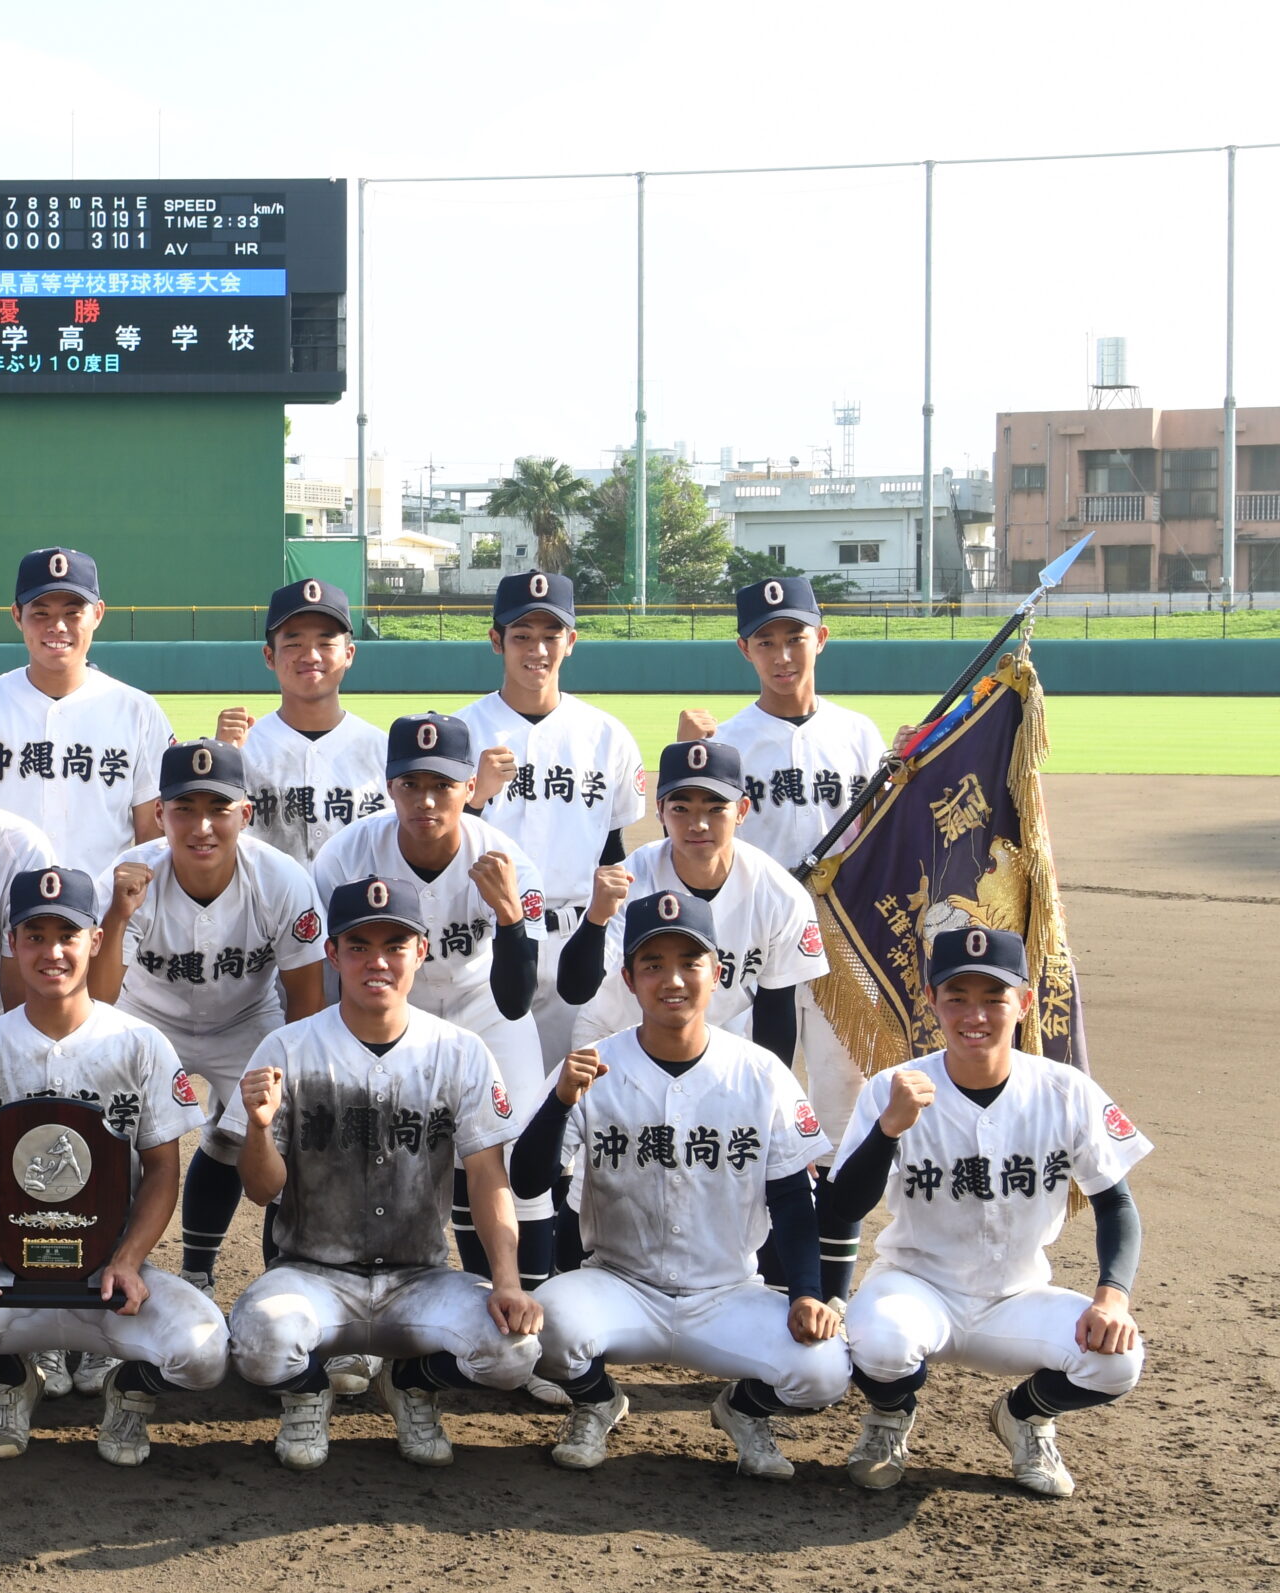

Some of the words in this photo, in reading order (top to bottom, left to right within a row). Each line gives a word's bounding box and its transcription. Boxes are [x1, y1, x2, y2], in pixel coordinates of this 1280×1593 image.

[8, 197, 16, 209] 7
[29, 197, 37, 209] 8
[49, 197, 58, 209] 9
[69, 197, 80, 209] 10
[92, 197, 103, 208] R
[114, 197, 124, 208] H
[137, 197, 147, 208] E
[165, 200, 216, 211] SPEED
[254, 203, 283, 214] km/h
[6, 212, 18, 228] 0
[27, 211, 38, 228] 0
[49, 211, 59, 228] 3
[90, 211, 105, 227] 10
[112, 211, 128, 227] 19
[138, 211, 144, 227] 1
[165, 216, 207, 228] TIME
[213, 216, 261, 229] 2:33
[6, 233, 18, 249] 0
[27, 233, 39, 249] 0
[48, 232, 59, 249] 0
[92, 232, 102, 248] 3
[112, 232, 128, 248] 10
[138, 232, 144, 248] 1
[165, 243, 188, 255] AV
[235, 243, 258, 254] HR
[487, 763, 604, 808] 縄尚学
[248, 786, 386, 826] 沖縄尚学
[874, 893, 913, 937] 主催
[135, 938, 274, 983] 沖縄尚学
[592, 1126, 761, 1171] 沖縄尚学
[904, 1152, 1070, 1202] 沖縄尚学
